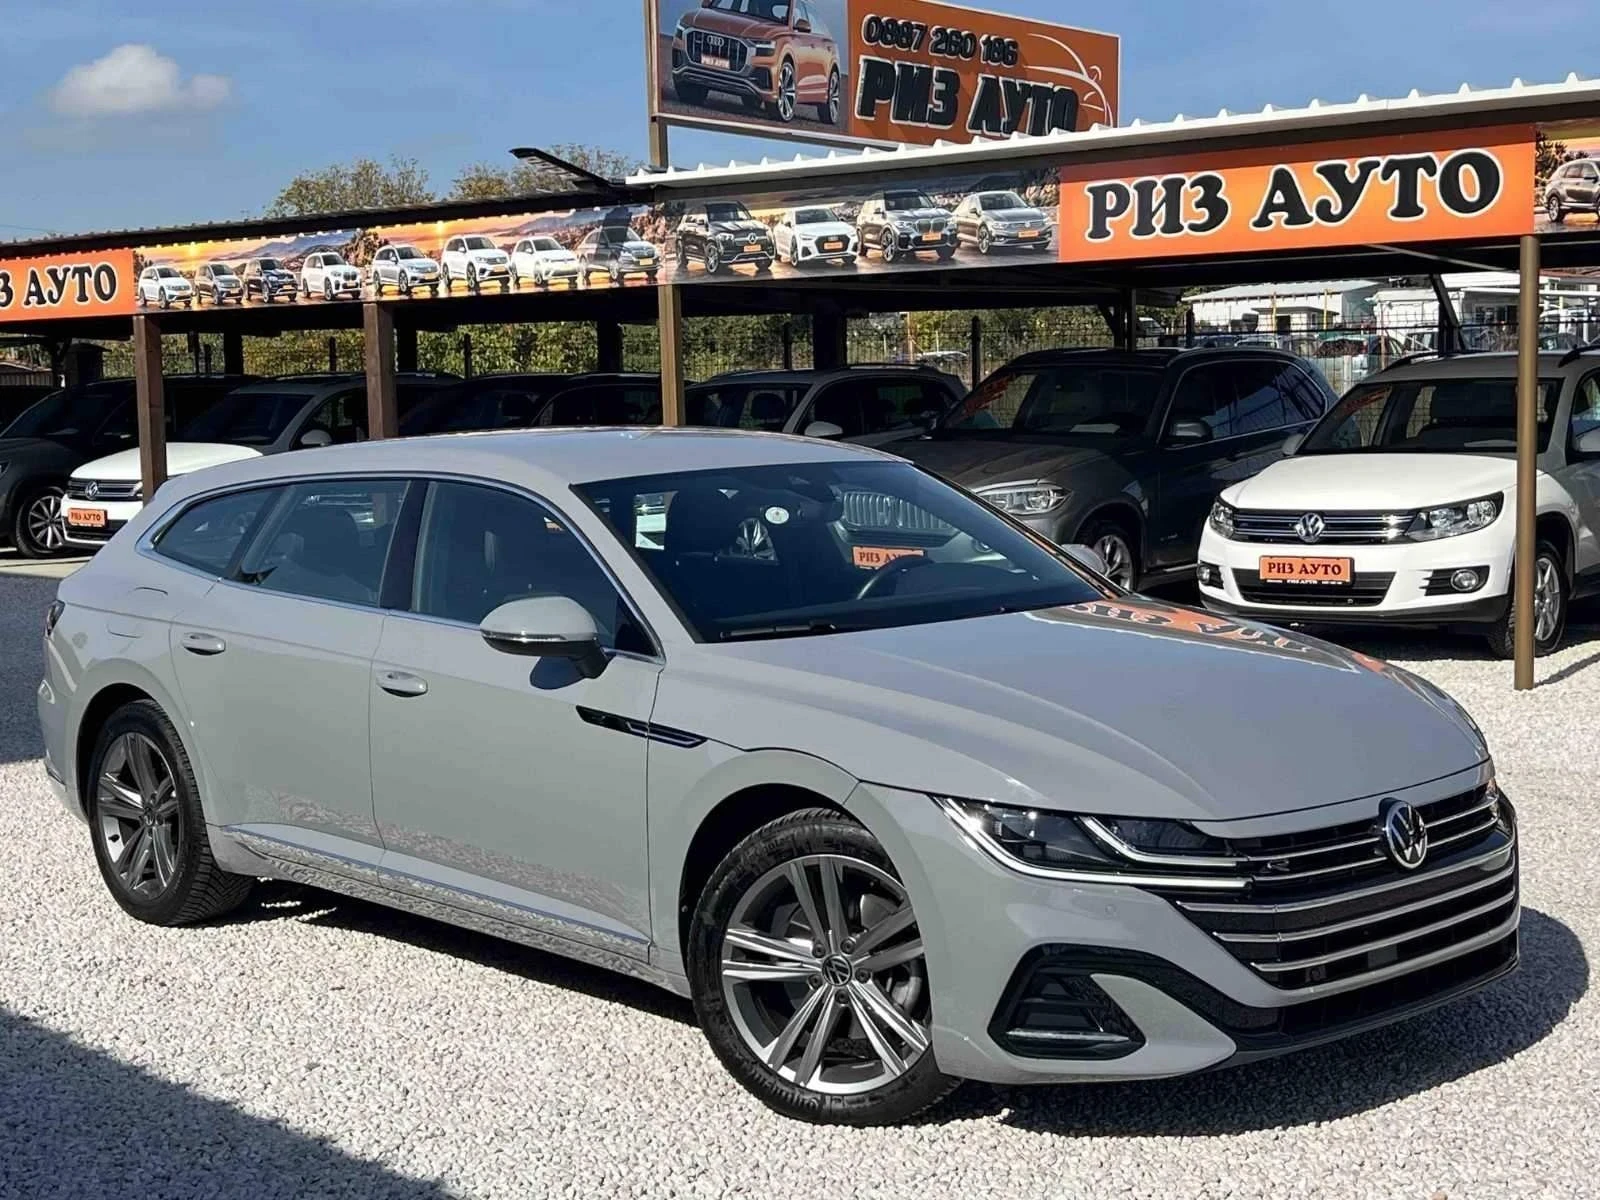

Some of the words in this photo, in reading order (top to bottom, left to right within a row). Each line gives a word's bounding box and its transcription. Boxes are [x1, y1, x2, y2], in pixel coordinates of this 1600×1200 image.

[861, 14, 928, 53] 0887
[928, 25, 977, 61] 260
[979, 34, 1020, 69] 186
[855, 55, 961, 129] РИЗ
[966, 73, 1079, 135] АУТО
[1085, 171, 1230, 243] РИЗ
[1249, 148, 1503, 231] АУТО
[22, 261, 118, 309] АУТО
[1267, 562, 1294, 574] РИЗ
[1299, 563, 1342, 575] АУТО
